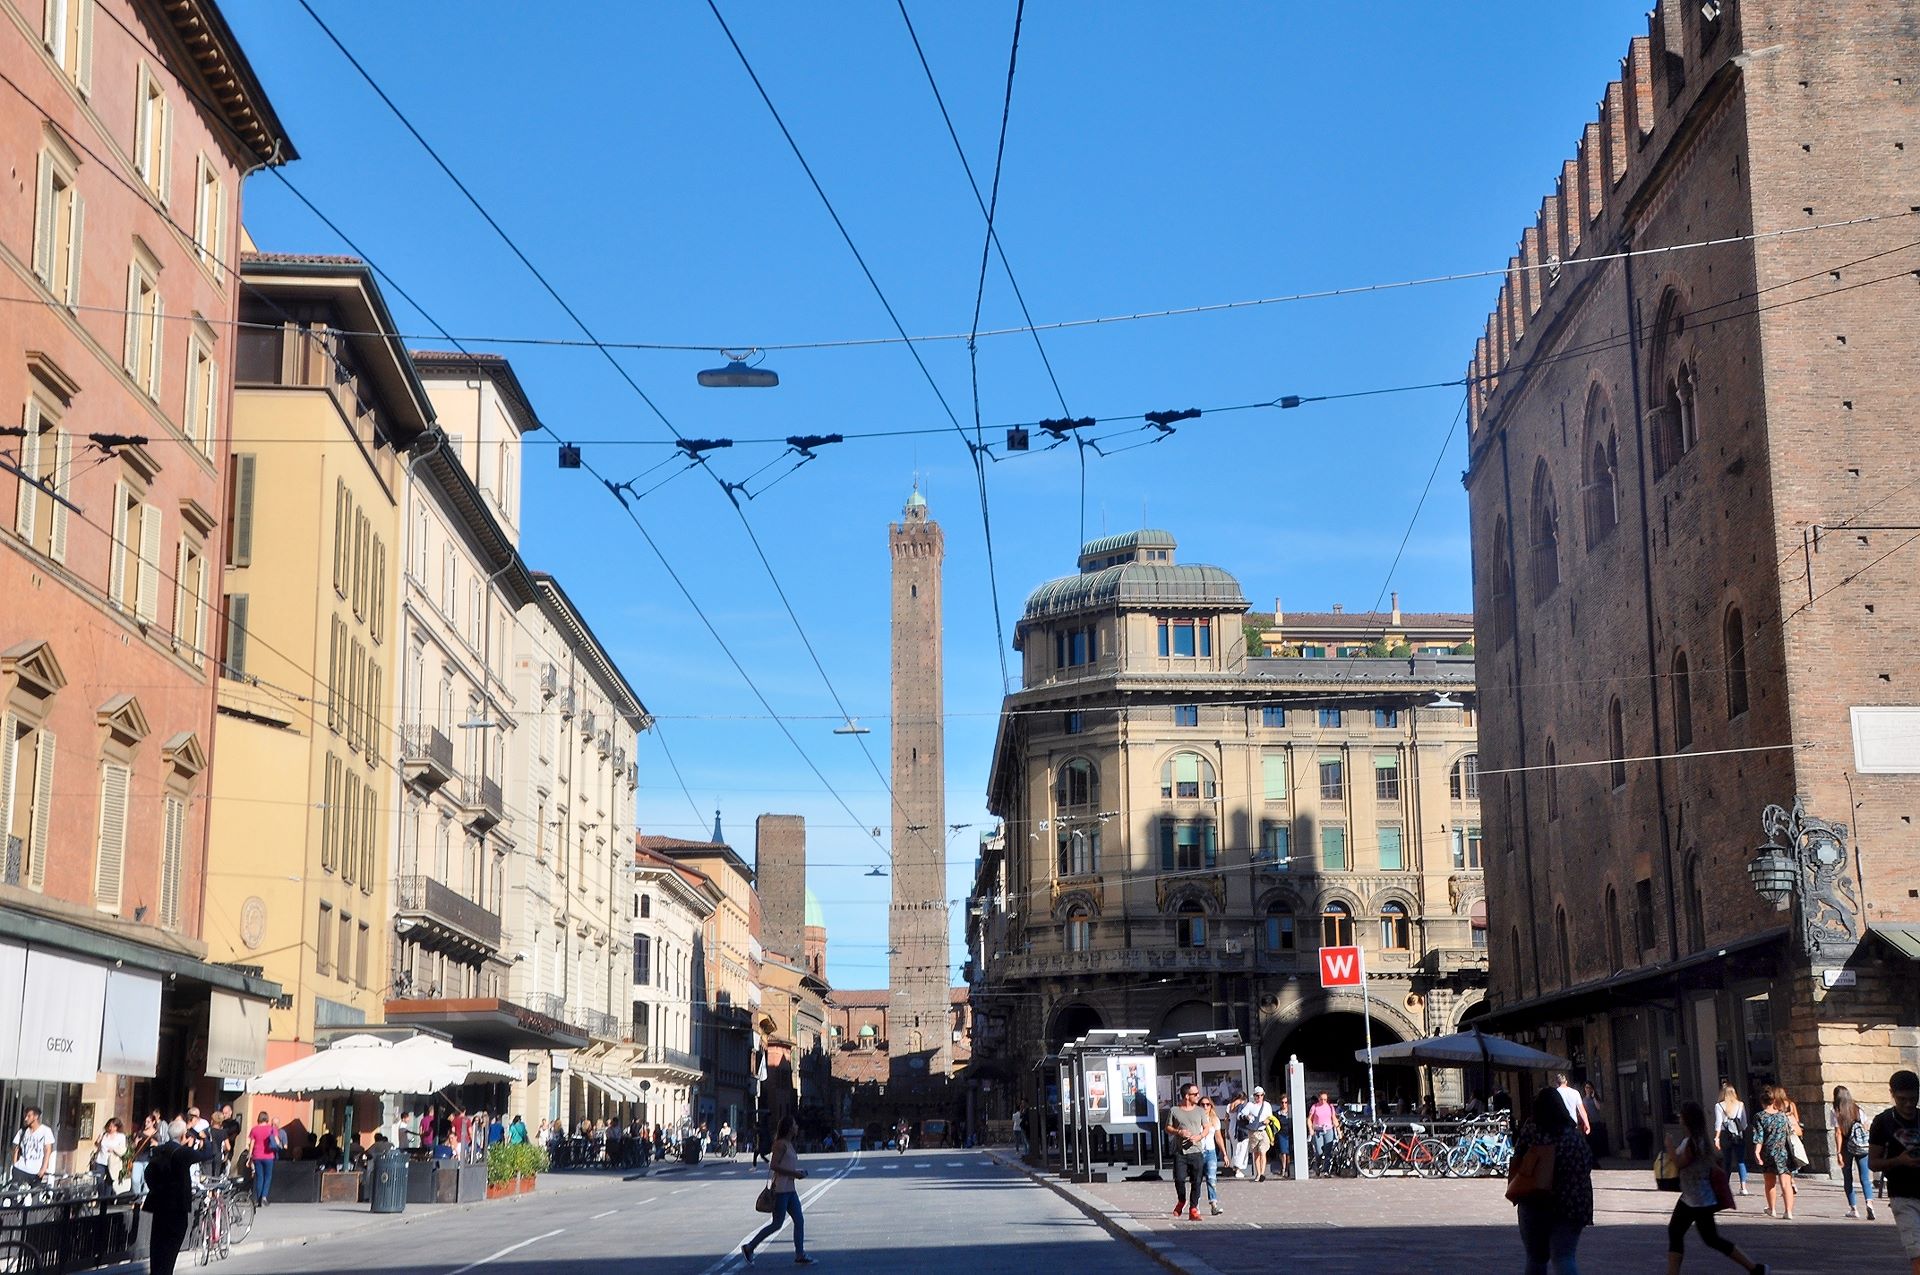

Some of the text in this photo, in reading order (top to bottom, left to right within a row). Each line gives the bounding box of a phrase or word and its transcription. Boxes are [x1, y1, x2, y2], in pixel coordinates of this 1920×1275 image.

[1008, 434, 1028, 448] 14
[1325, 954, 1354, 979] W
[46, 1036, 74, 1053] GEOX
